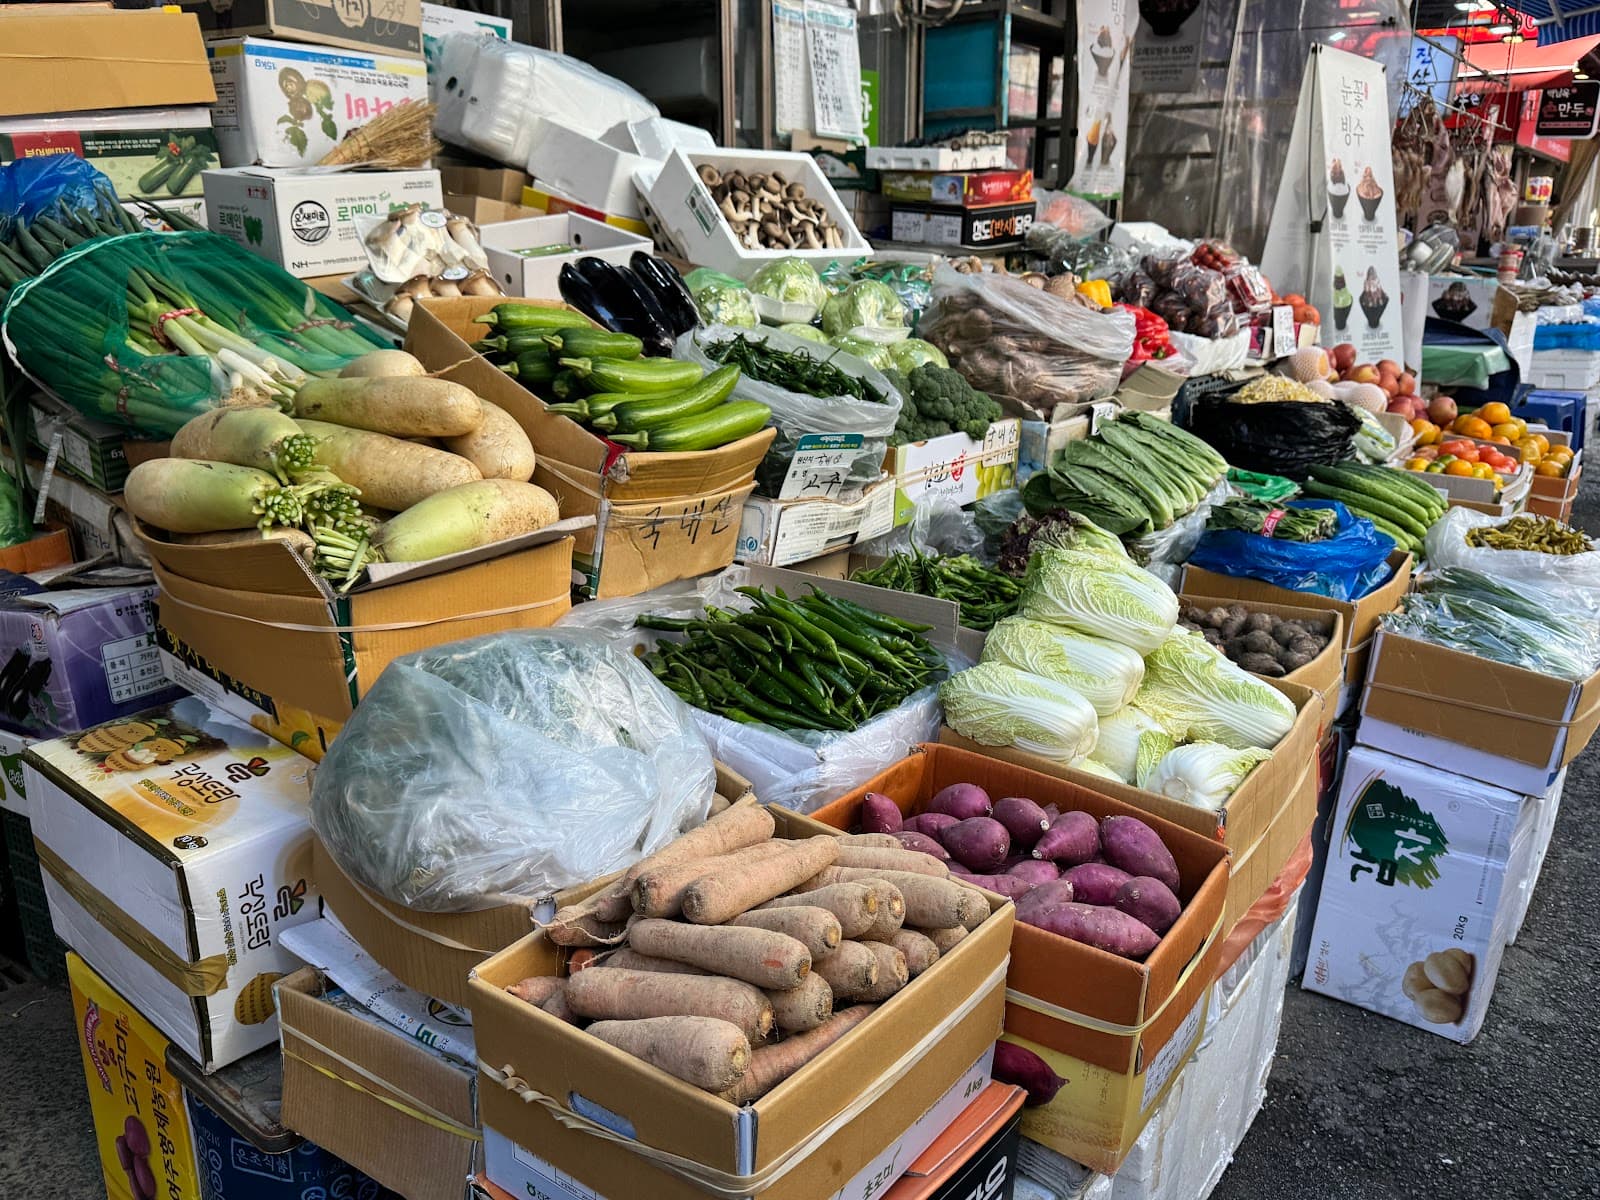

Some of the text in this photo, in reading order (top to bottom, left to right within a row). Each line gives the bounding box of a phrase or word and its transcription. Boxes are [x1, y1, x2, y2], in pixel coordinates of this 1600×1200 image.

[254, 59, 278, 71] 15kg
[1341, 76, 1365, 109] 눈꽃
[1341, 114, 1365, 147] 빙수
[294, 207, 327, 227] 온새미로
[292, 259, 309, 270] NH
[802, 472, 842, 496] 고추
[639, 497, 733, 551] 국내산
[169, 761, 241, 805] 곡성토란
[1350, 827, 1431, 886] 감자
[238, 874, 271, 950] 곡성토란
[1453, 915, 1468, 941] 20kg
[115, 1017, 141, 1114] 고구마
[963, 1076, 984, 1099] 4kg
[862, 1143, 904, 1199] 초로미
